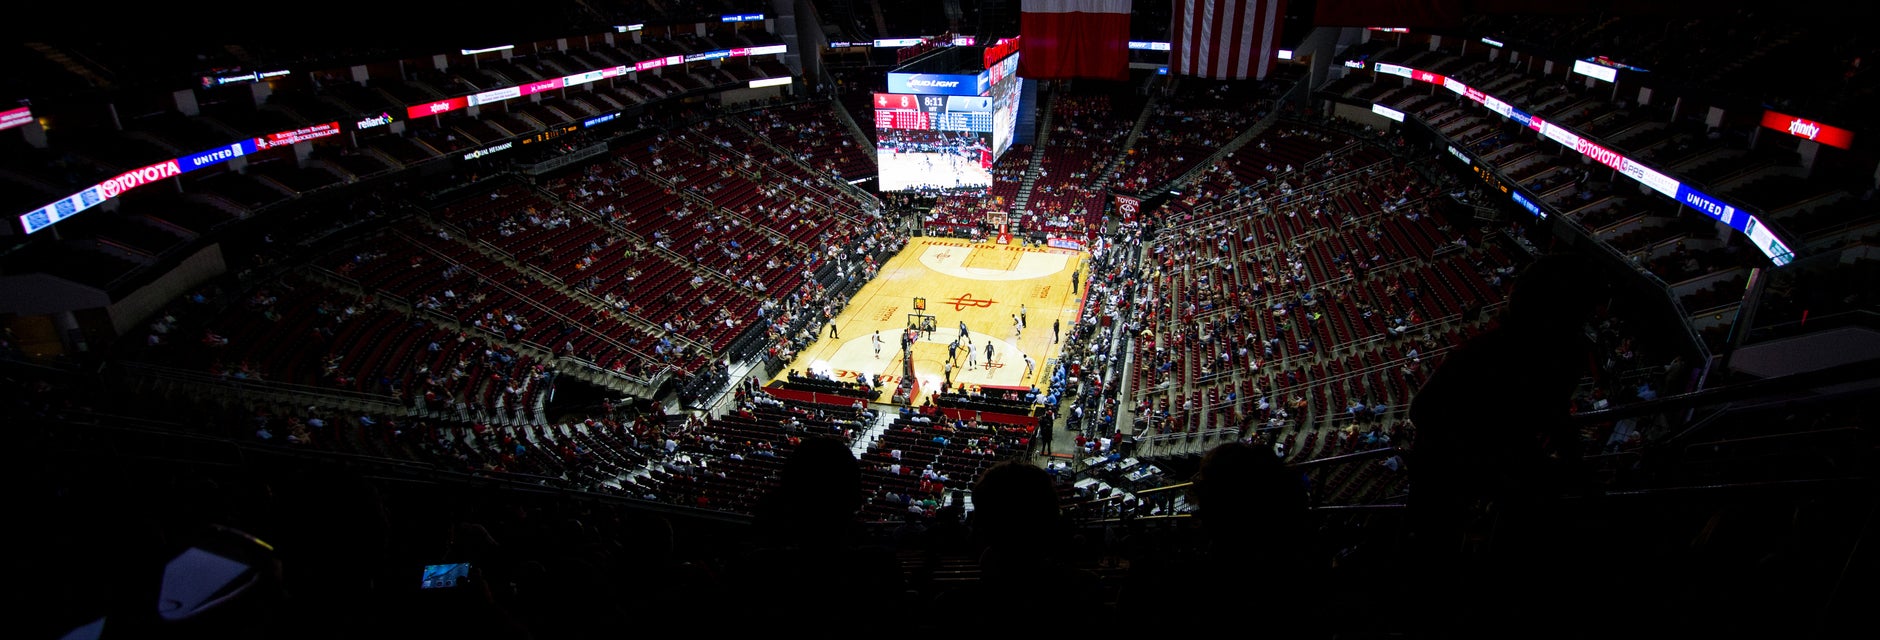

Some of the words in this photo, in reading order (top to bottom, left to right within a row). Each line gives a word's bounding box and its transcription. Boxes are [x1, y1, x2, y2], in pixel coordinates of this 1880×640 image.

[931, 80, 959, 88] LIGHT
[430, 102, 449, 113] xfinity
[901, 96, 908, 107] 8
[924, 97, 943, 106] 8:11
[357, 116, 385, 129] reliant
[1788, 118, 1820, 140] xfinity
[193, 149, 232, 166] UNITED
[1586, 143, 1620, 170] TOYOTA
[117, 161, 181, 191] TOYOTA
[1627, 165, 1644, 179] PPS
[1117, 196, 1138, 207] TOYOTA
[1687, 192, 1722, 216] UNITED
[921, 240, 996, 250] HOUSTON
